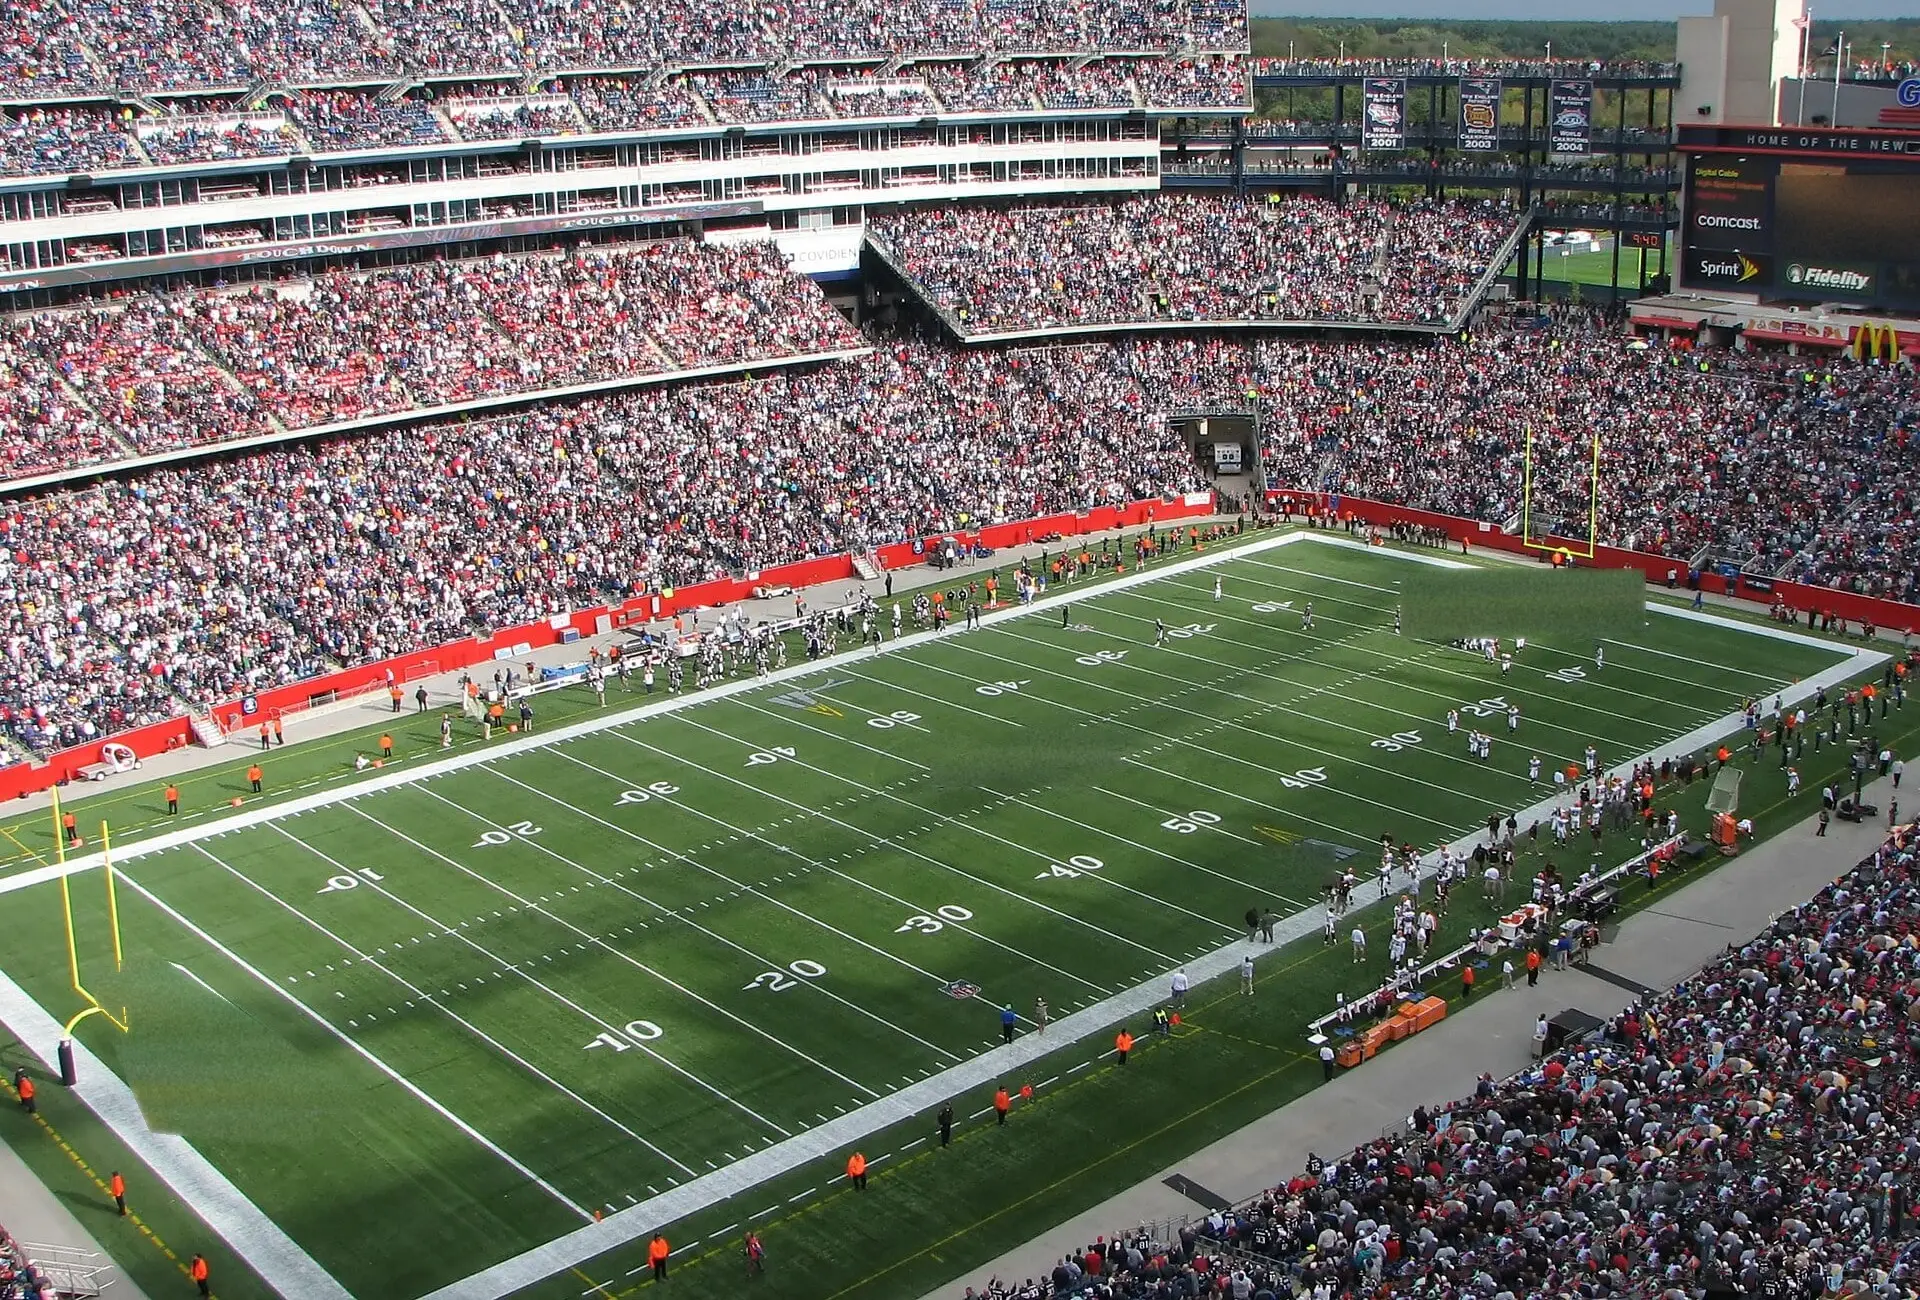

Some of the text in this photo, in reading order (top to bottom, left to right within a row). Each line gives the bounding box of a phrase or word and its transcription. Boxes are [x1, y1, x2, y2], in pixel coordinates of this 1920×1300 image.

[1371, 138, 1397, 147] 2001
[1465, 140, 1491, 148] 2003
[1556, 143, 1583, 151] 2004
[1747, 135, 1905, 151] HOME OF THE NEW
[1695, 168, 1739, 178] Digital Cable
[1697, 214, 1760, 230] comcast
[1632, 234, 1658, 246] 9:40
[237, 243, 370, 261] TOUCHDOWN
[799, 247, 857, 262] COVIDIEN
[1700, 260, 1739, 277] Sprint
[1804, 267, 1870, 290] Fidelity
[1167, 623, 1213, 638] 20
[1075, 650, 1125, 667] 30
[1544, 667, 1587, 684] 10
[975, 680, 1019, 697] 40
[1460, 698, 1509, 718] 20
[866, 710, 922, 730] 50
[1370, 732, 1423, 753] 30
[748, 746, 797, 765] 40
[1279, 769, 1329, 790] 40
[620, 781, 681, 803] 30
[1160, 810, 1222, 834] 50
[480, 820, 543, 845] 20
[1050, 855, 1105, 880] 40
[327, 867, 385, 890] 10
[905, 904, 974, 933] 30
[754, 959, 827, 992] 20
[595, 1020, 664, 1052] 10
[1311, 1162, 1321, 1171] 12
[1139, 1240, 1149, 1250] 81
